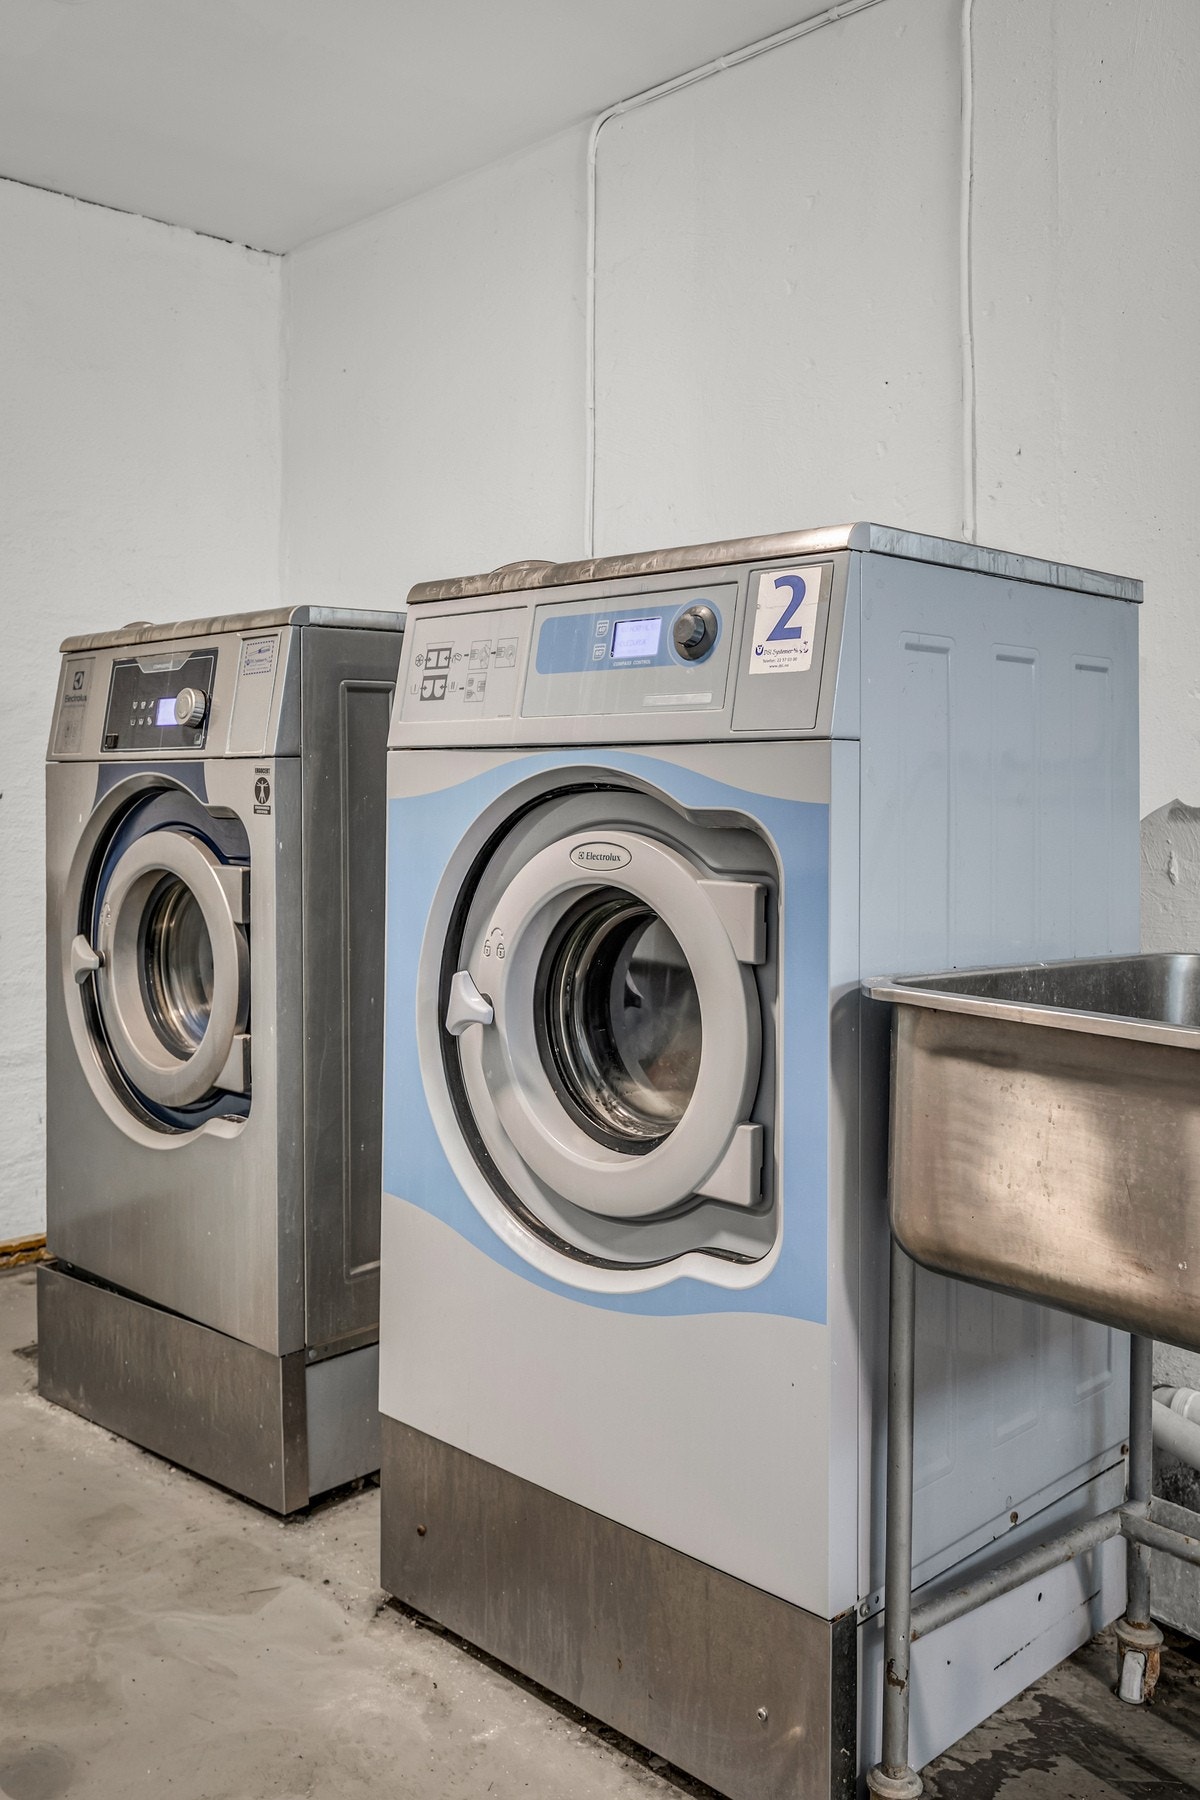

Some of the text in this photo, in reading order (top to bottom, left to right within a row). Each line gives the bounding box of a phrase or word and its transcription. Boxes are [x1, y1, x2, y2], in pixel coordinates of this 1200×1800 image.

[764, 574, 806, 641] 2
[64, 694, 87, 703] Electrolux
[586, 851, 621, 861] Electrolux
